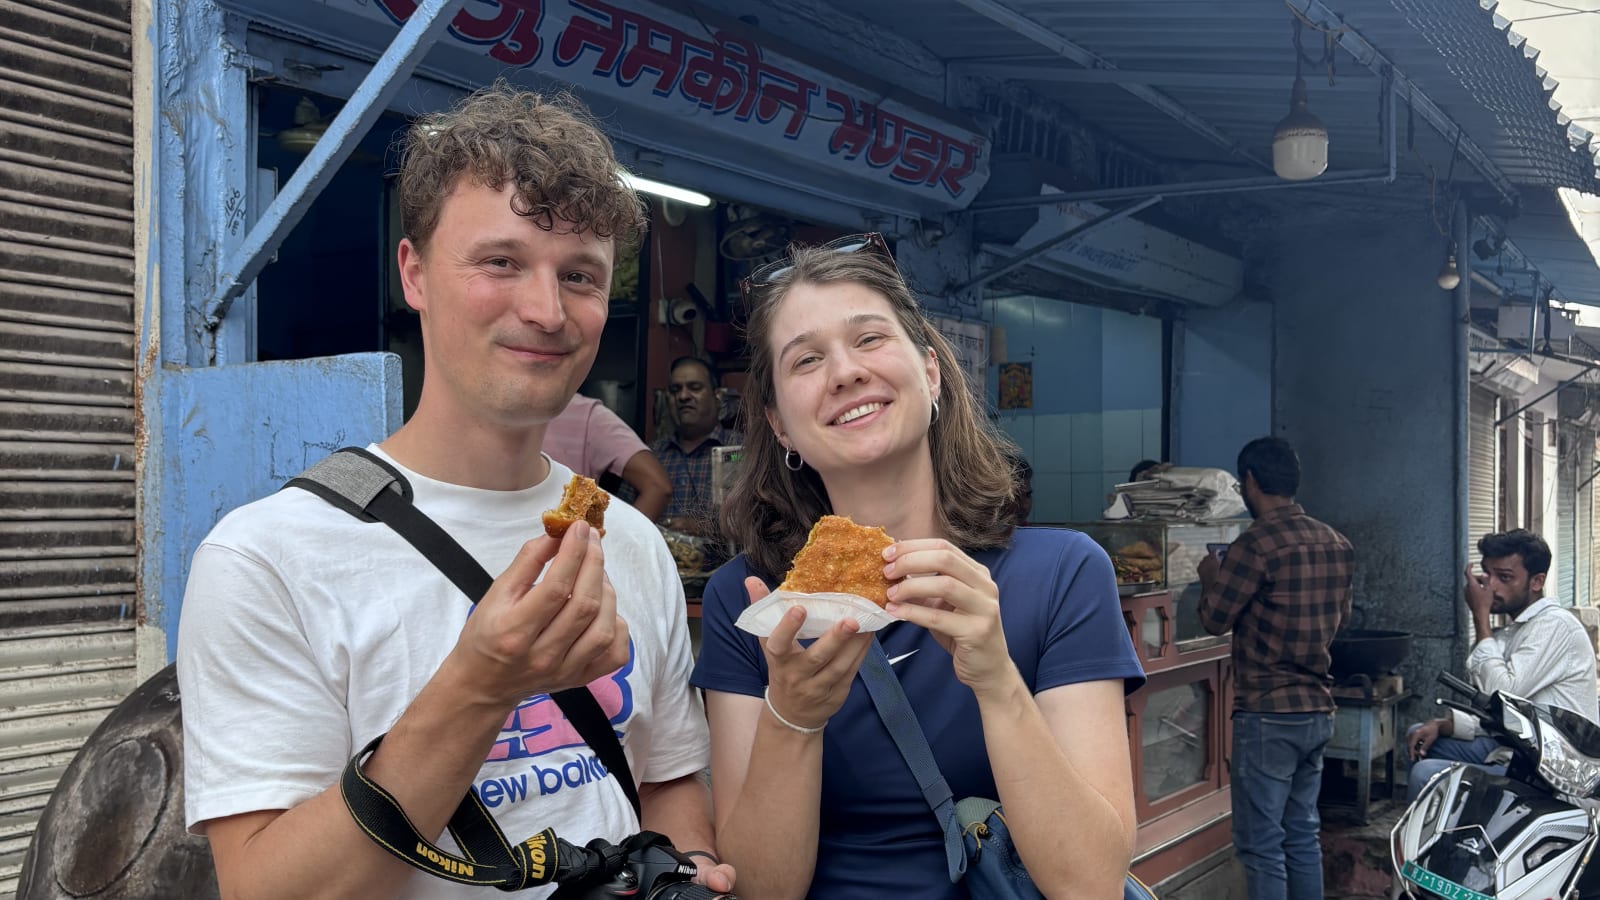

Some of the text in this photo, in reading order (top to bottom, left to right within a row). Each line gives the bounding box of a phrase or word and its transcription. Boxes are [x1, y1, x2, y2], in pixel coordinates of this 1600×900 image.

[553, 0, 819, 140] नमकीन
[825, 88, 983, 198] भण्डार
[471, 774, 528, 808] ew
[415, 841, 475, 878] Nikon
[524, 833, 547, 880] ikon
[677, 864, 698, 876] Nikon
